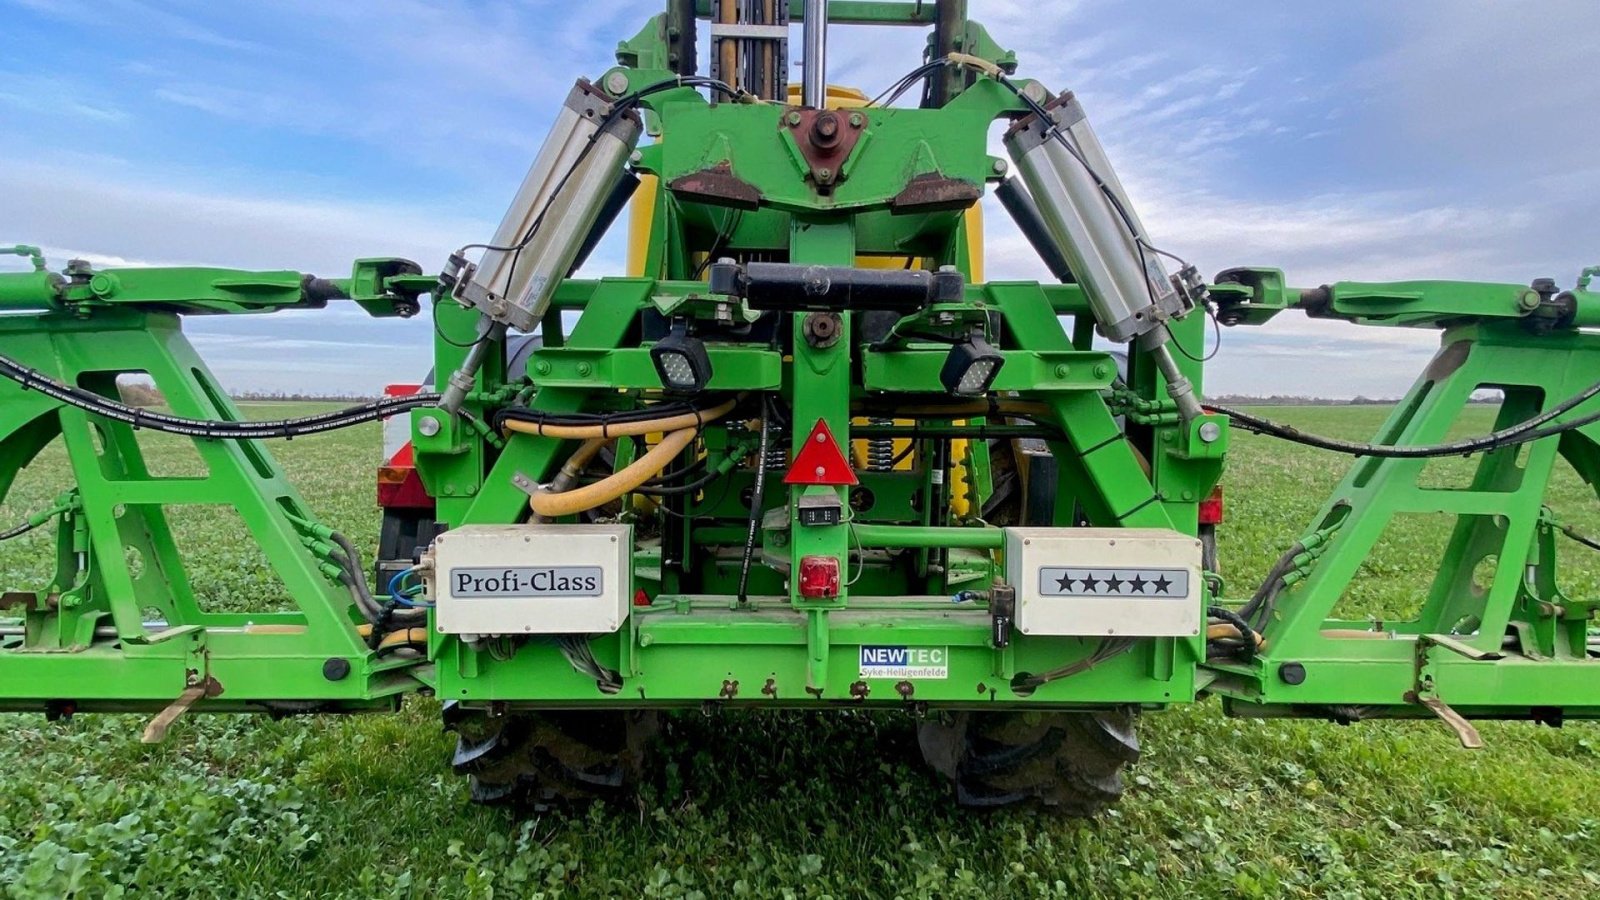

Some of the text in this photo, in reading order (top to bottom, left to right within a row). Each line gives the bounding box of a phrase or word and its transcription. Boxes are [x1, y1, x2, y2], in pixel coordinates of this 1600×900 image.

[457, 570, 596, 592] Profi-Class
[863, 648, 942, 663] NEWTEC
[862, 668, 946, 679] Syke-Heiligenfelde
